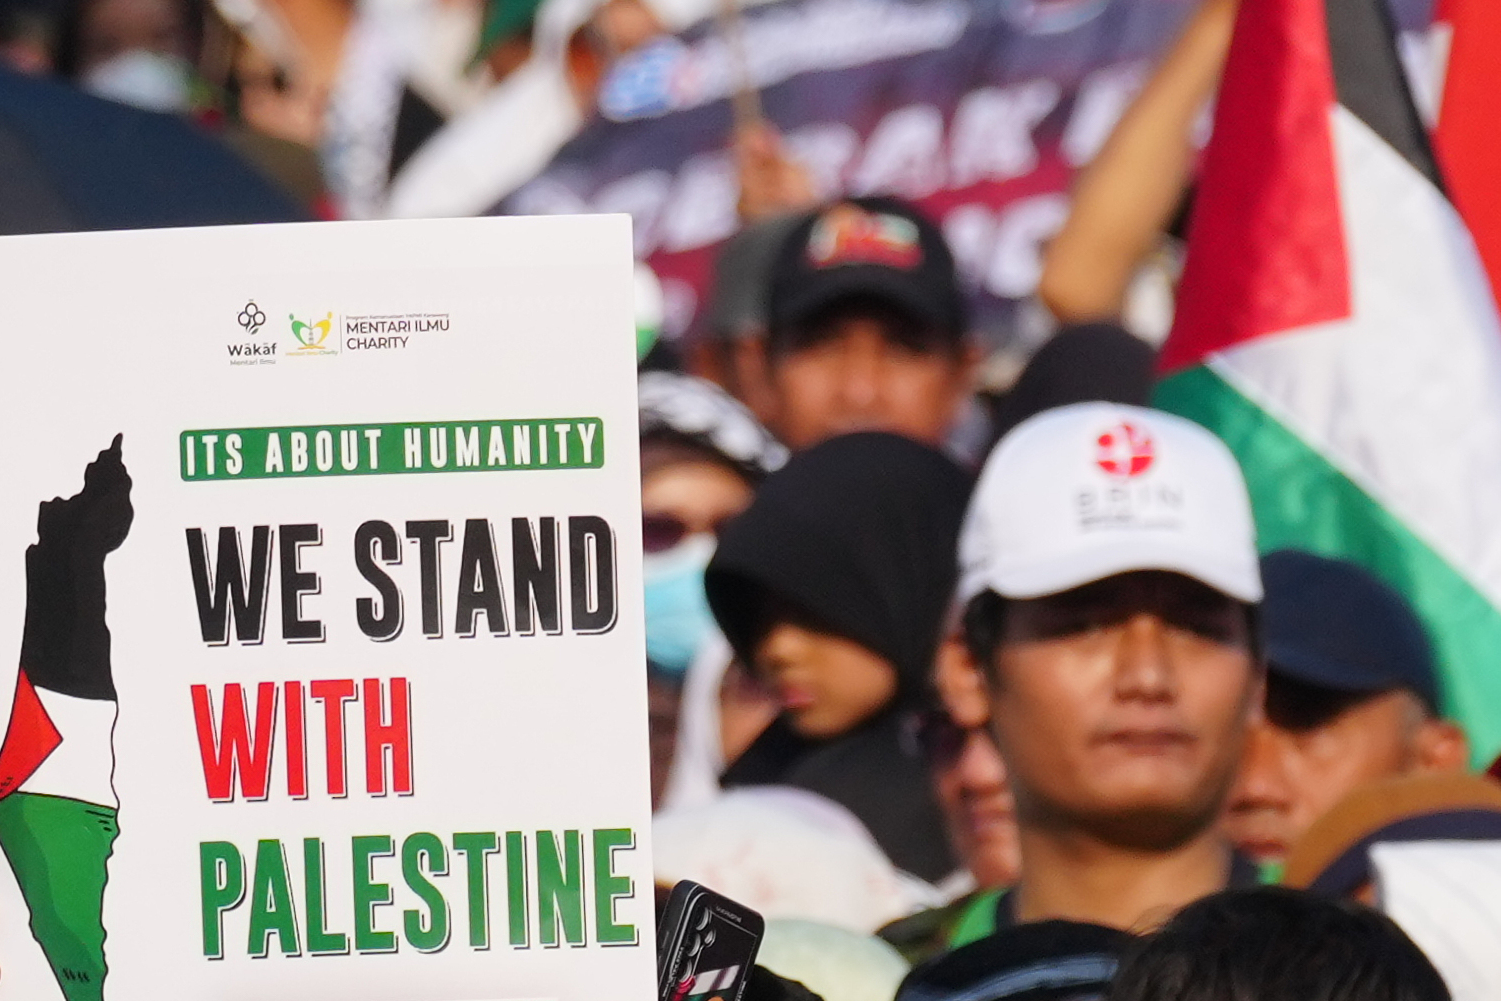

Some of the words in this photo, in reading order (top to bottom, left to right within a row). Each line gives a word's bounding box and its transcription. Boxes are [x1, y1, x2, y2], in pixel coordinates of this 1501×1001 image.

[346, 320, 411, 335] MENTARI
[414, 318, 450, 333] ILMU
[346, 335, 409, 350] CHARITY
[184, 433, 242, 477] ITS
[264, 428, 382, 474] ABOUT
[403, 423, 598, 469] HUMANITY
[185, 523, 326, 647] WE
[354, 515, 618, 642] STAND
[190, 677, 414, 804] WITH
[200, 828, 639, 961] PALESTINE
